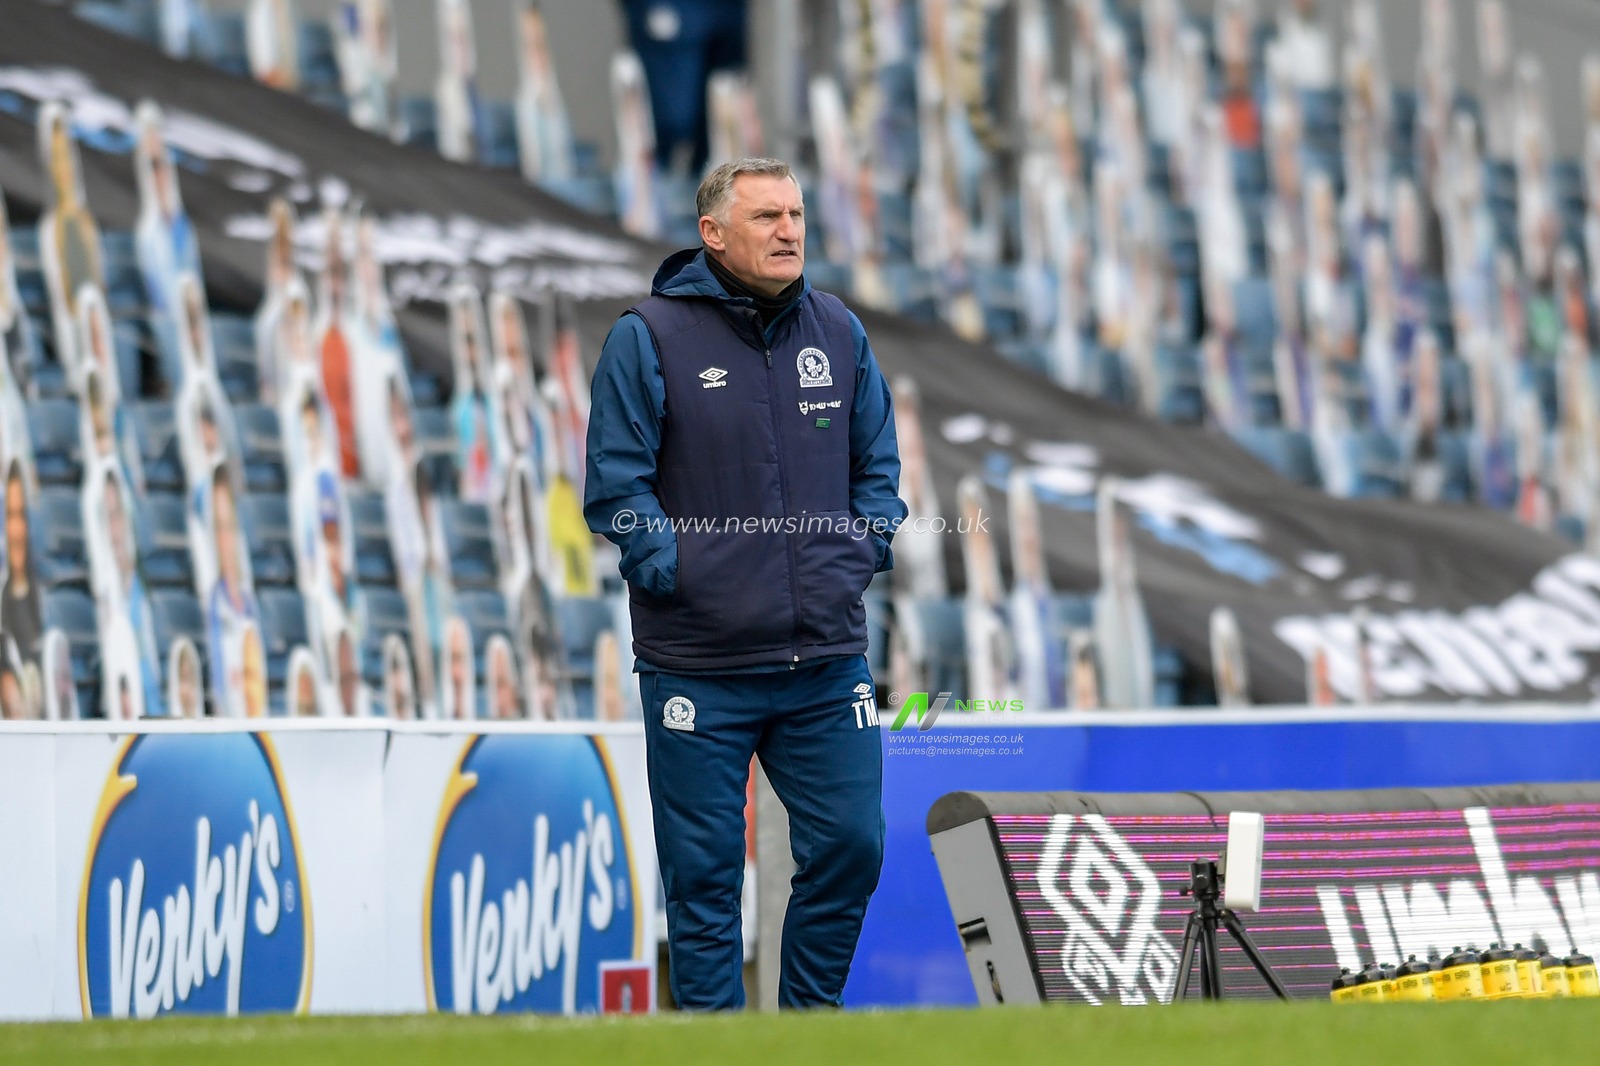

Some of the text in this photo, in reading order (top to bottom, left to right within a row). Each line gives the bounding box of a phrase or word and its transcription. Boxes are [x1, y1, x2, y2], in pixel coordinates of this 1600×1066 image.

[702, 381, 727, 389] umbro
[852, 698, 880, 729] TM
[110, 799, 281, 1020] Venky's
[452, 798, 613, 1014] Venky's
